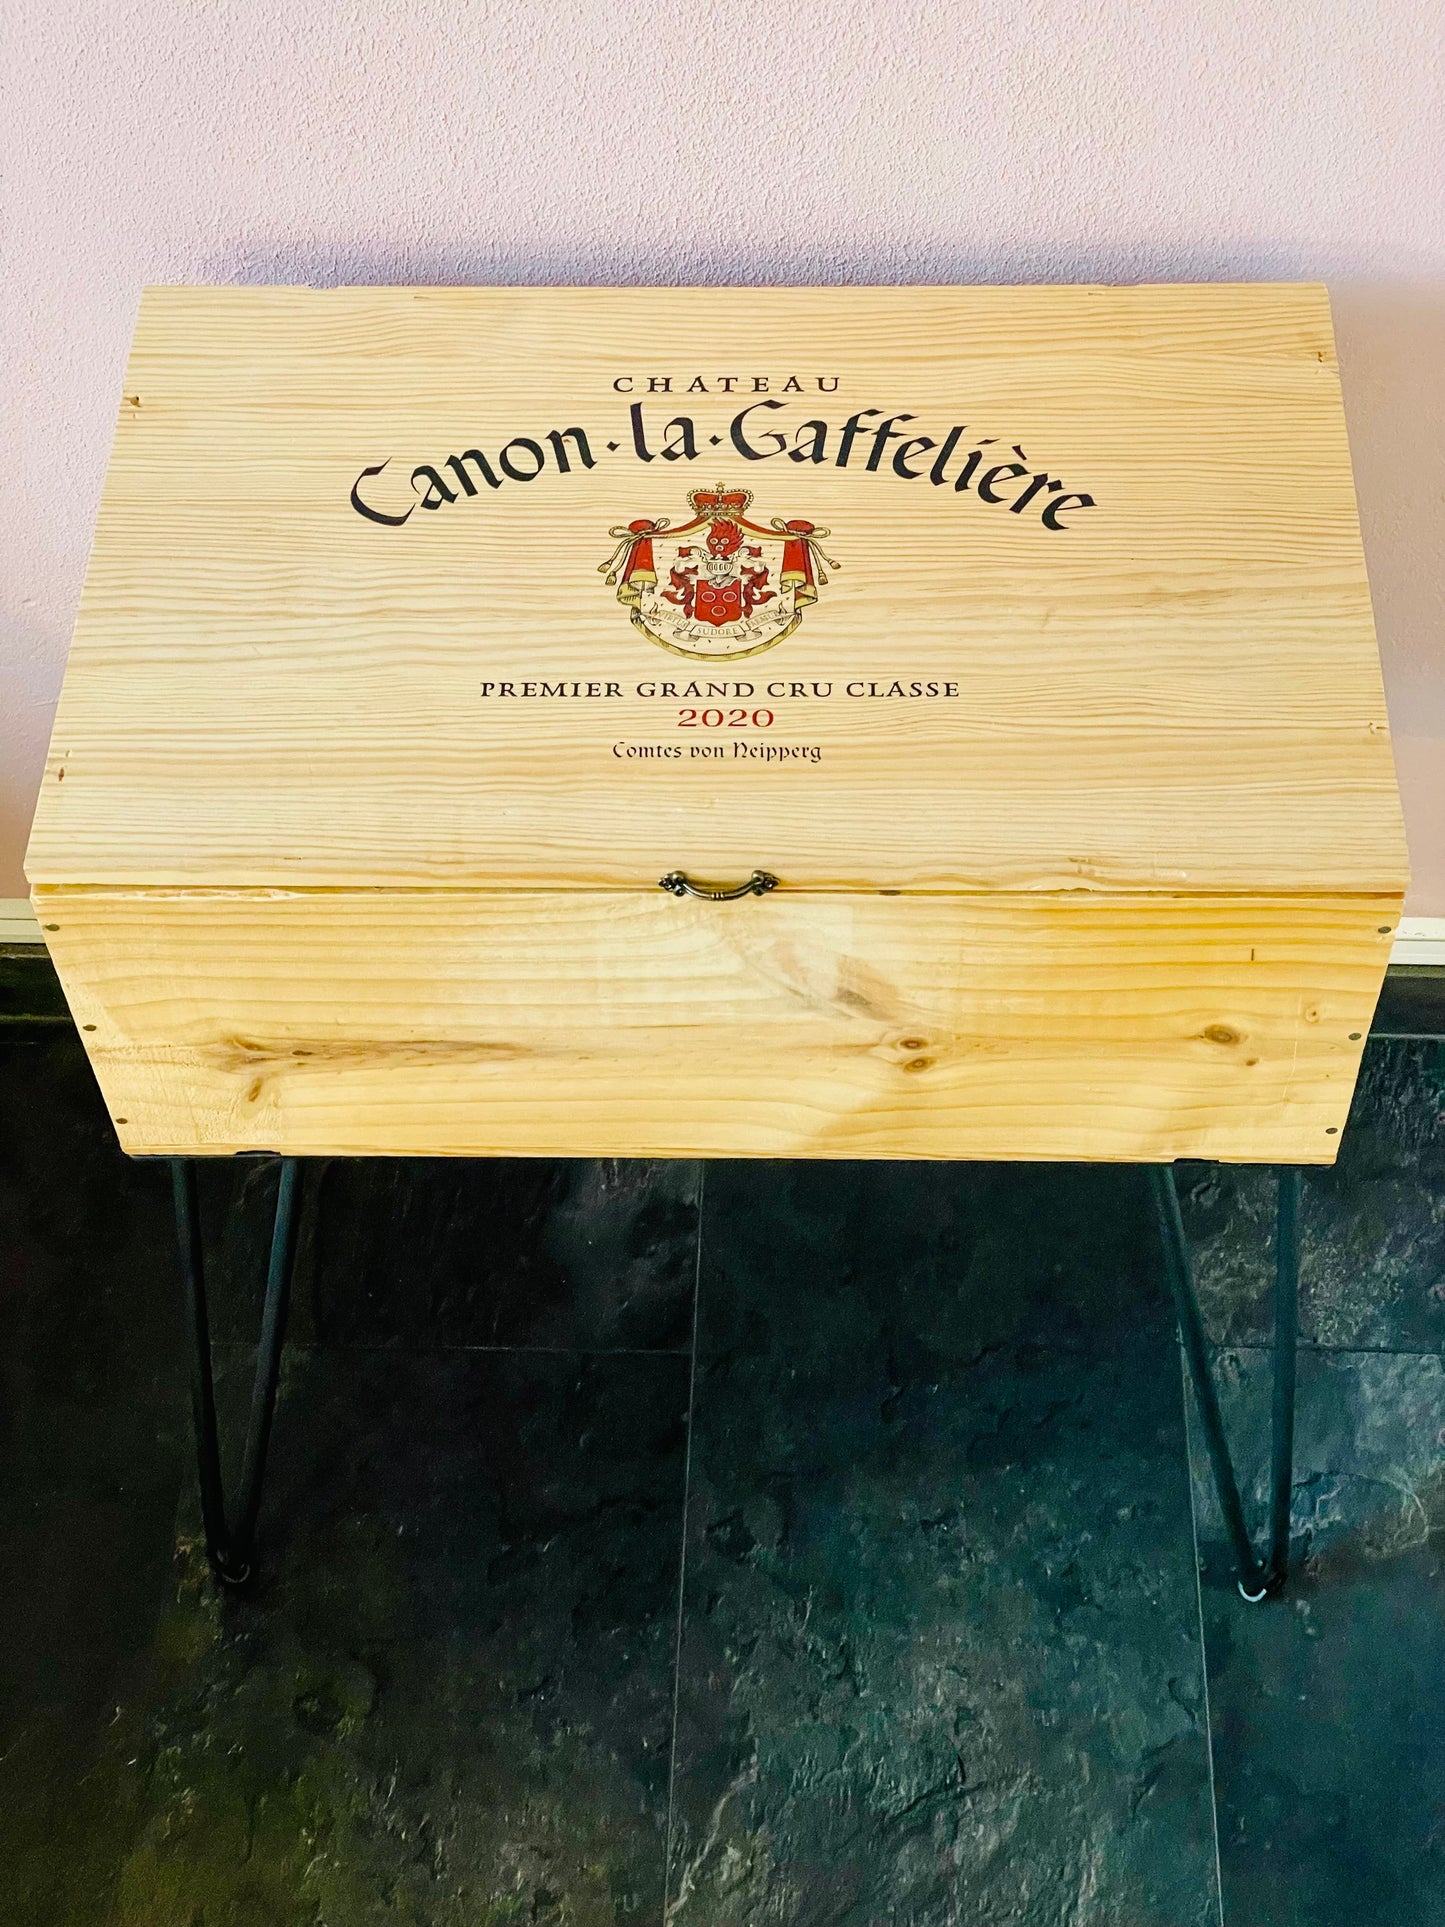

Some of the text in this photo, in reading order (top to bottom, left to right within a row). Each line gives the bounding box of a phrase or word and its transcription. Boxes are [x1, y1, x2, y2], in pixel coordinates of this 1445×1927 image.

[613, 375, 840, 393] CHATEAU
[697, 628, 738, 636] SUDORE
[480, 680, 960, 698] PREMIER GRAND CRU CLASSE
[677, 709, 774, 728] 2020
[612, 741, 822, 764] Comtes von Neipperg
